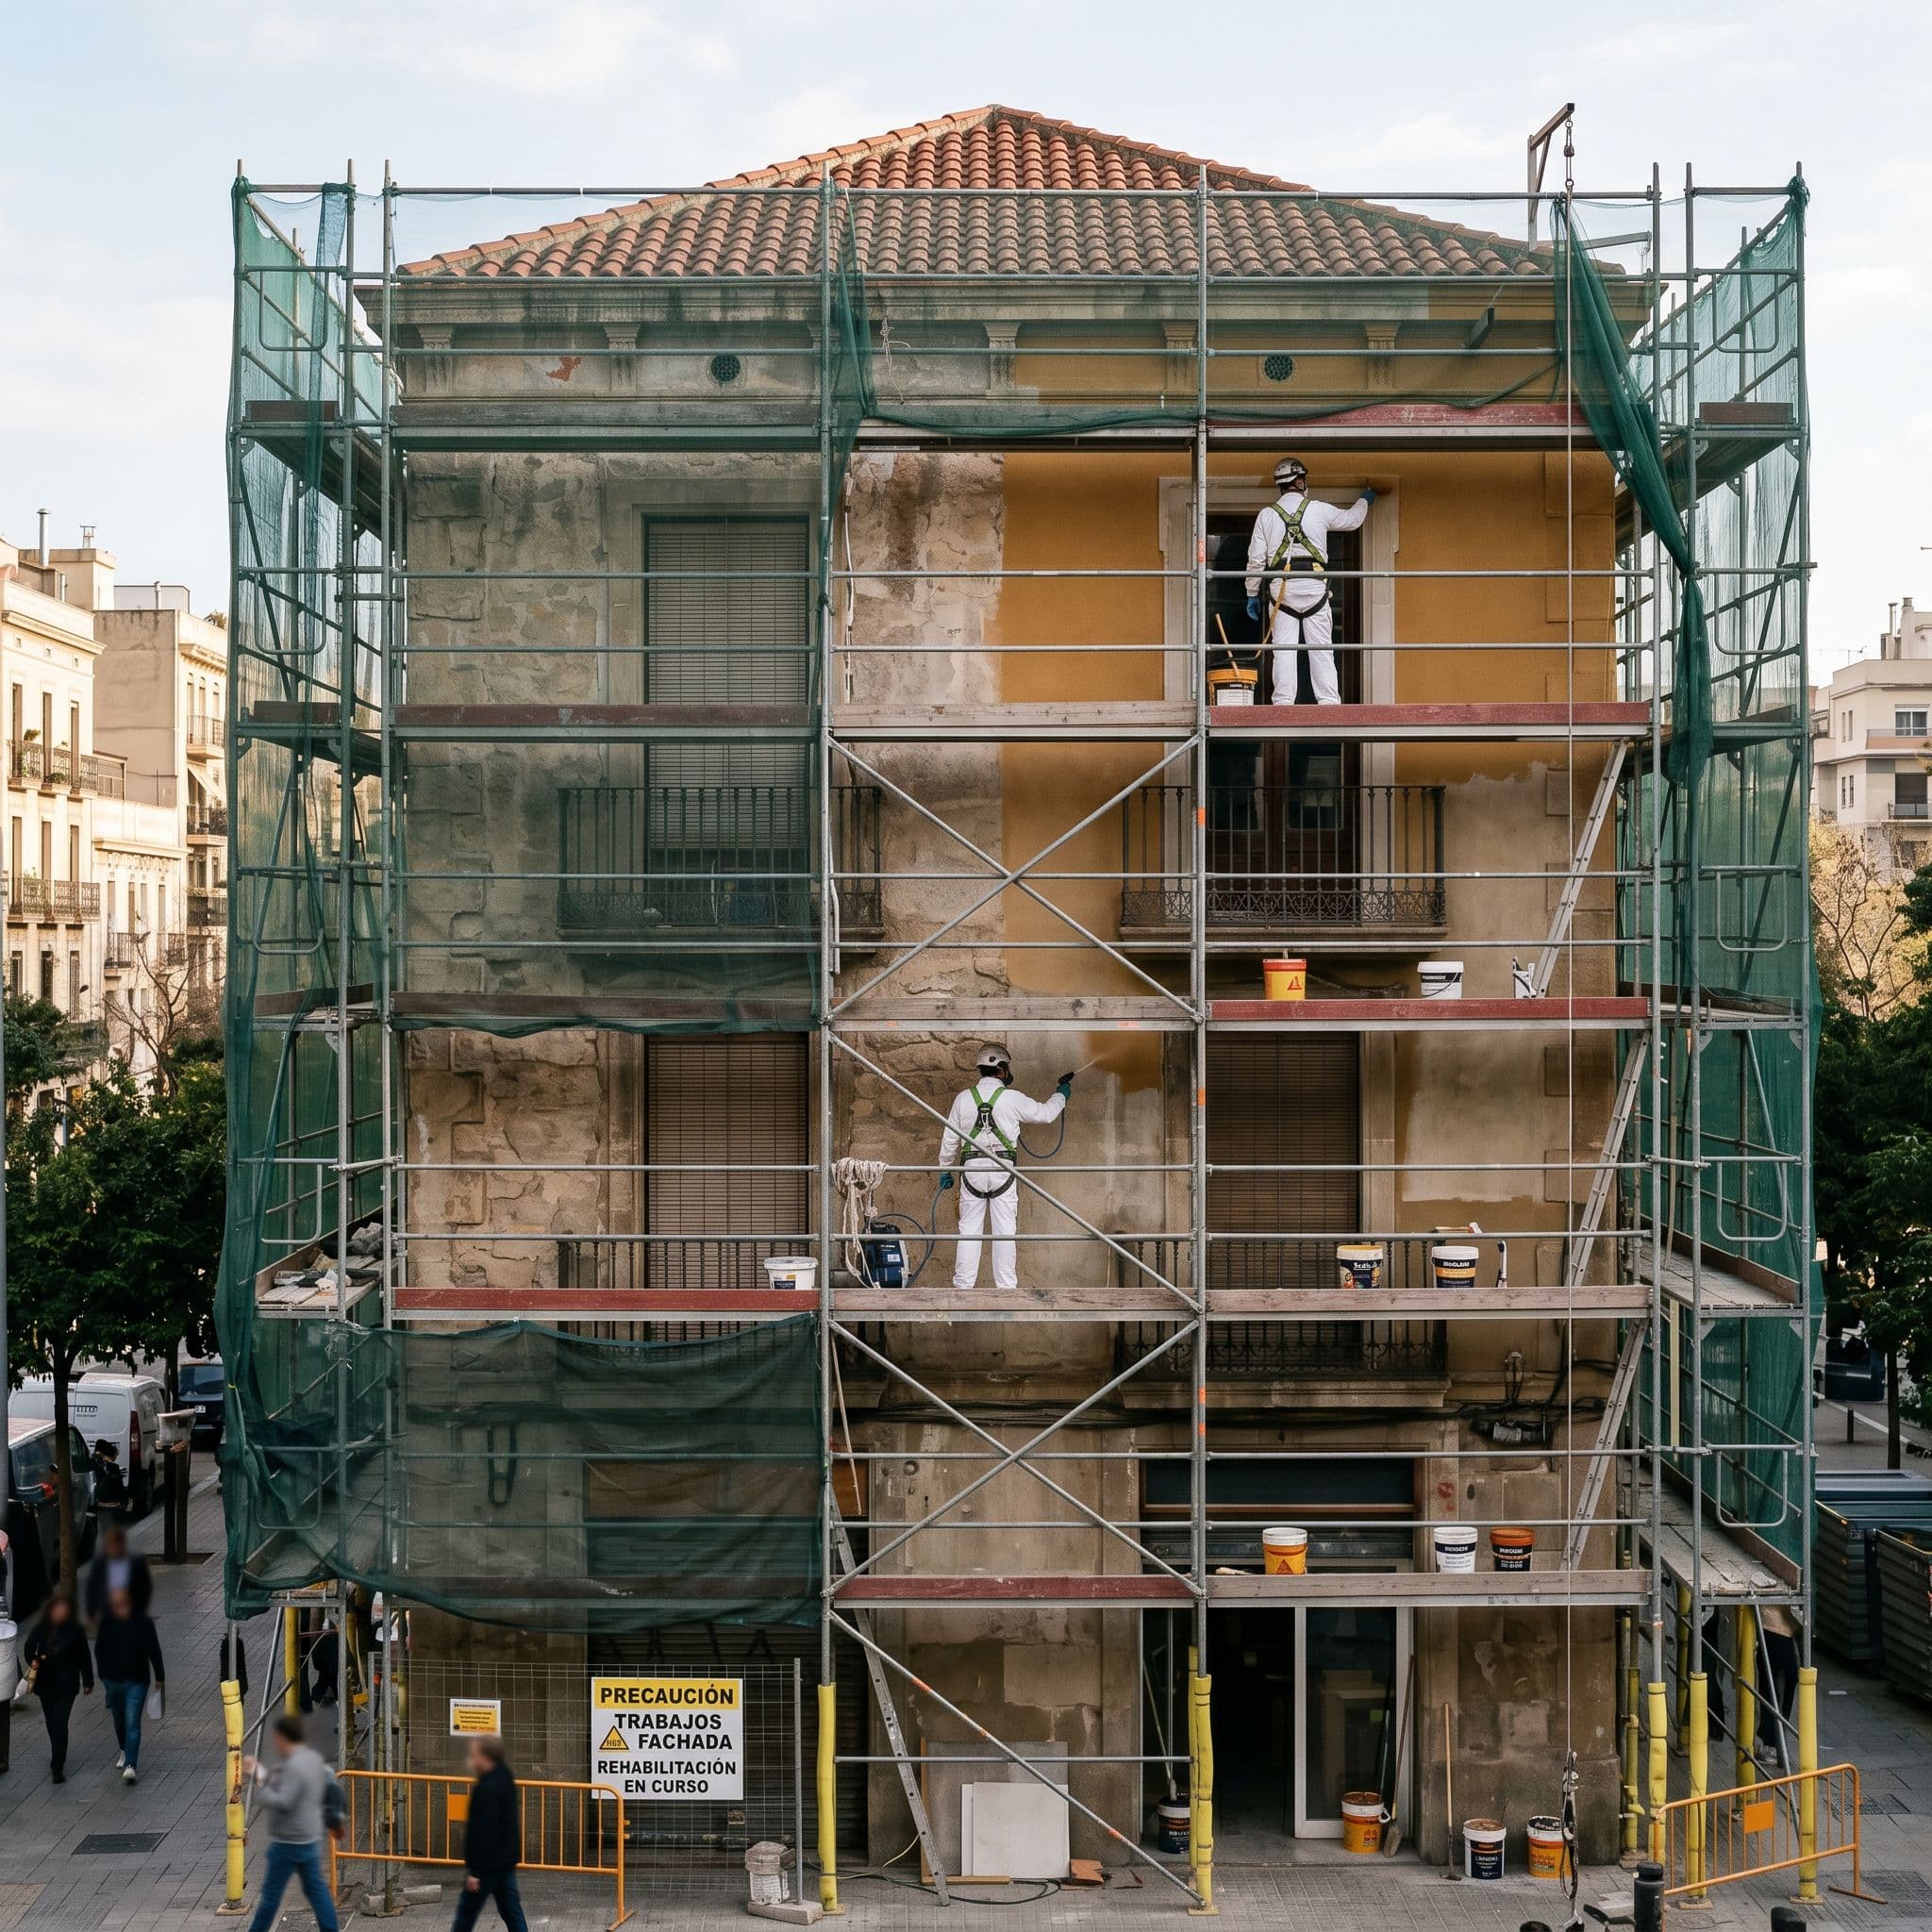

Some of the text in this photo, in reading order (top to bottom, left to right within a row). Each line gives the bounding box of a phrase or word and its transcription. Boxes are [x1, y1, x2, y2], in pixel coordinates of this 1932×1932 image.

[601, 1683, 733, 1704] PRECAUCIÓN
[614, 1713, 722, 1729] TRABAJOS
[639, 1734, 732, 1749] FACHADA
[598, 1757, 736, 1774] REHABILITACIÓN
[625, 1779, 708, 1792] EN CURSO
